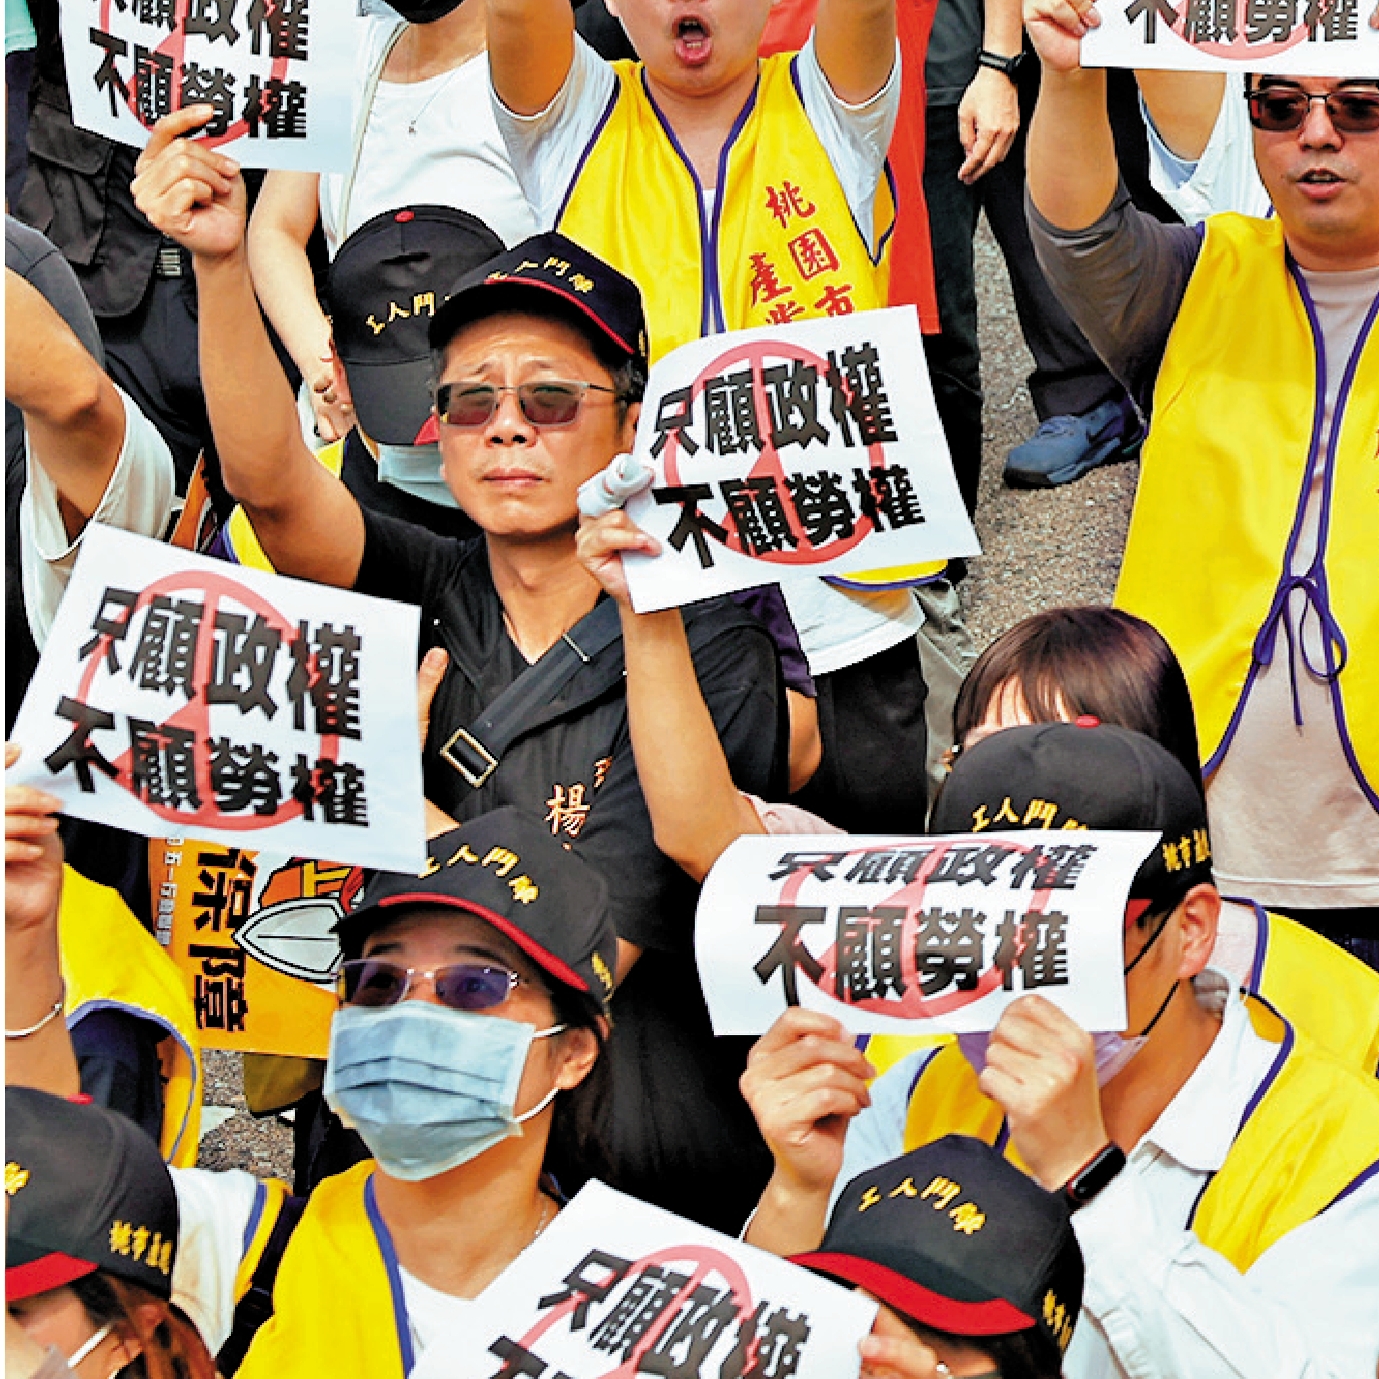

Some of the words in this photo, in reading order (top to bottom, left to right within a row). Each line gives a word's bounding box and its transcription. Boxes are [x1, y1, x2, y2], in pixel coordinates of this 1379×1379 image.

[89, 28, 308, 140] 不顧勞權
[649, 342, 899, 460] 只顧政權
[653, 466, 926, 569] 不顧勞權
[79, 588, 364, 742] 只顧政權
[46, 695, 370, 827] 不顧勞權
[544, 783, 589, 835] 楊
[768, 845, 1098, 892] 只顧政權
[188, 849, 258, 1031] 保障
[752, 904, 1070, 1009] 不顧勞權
